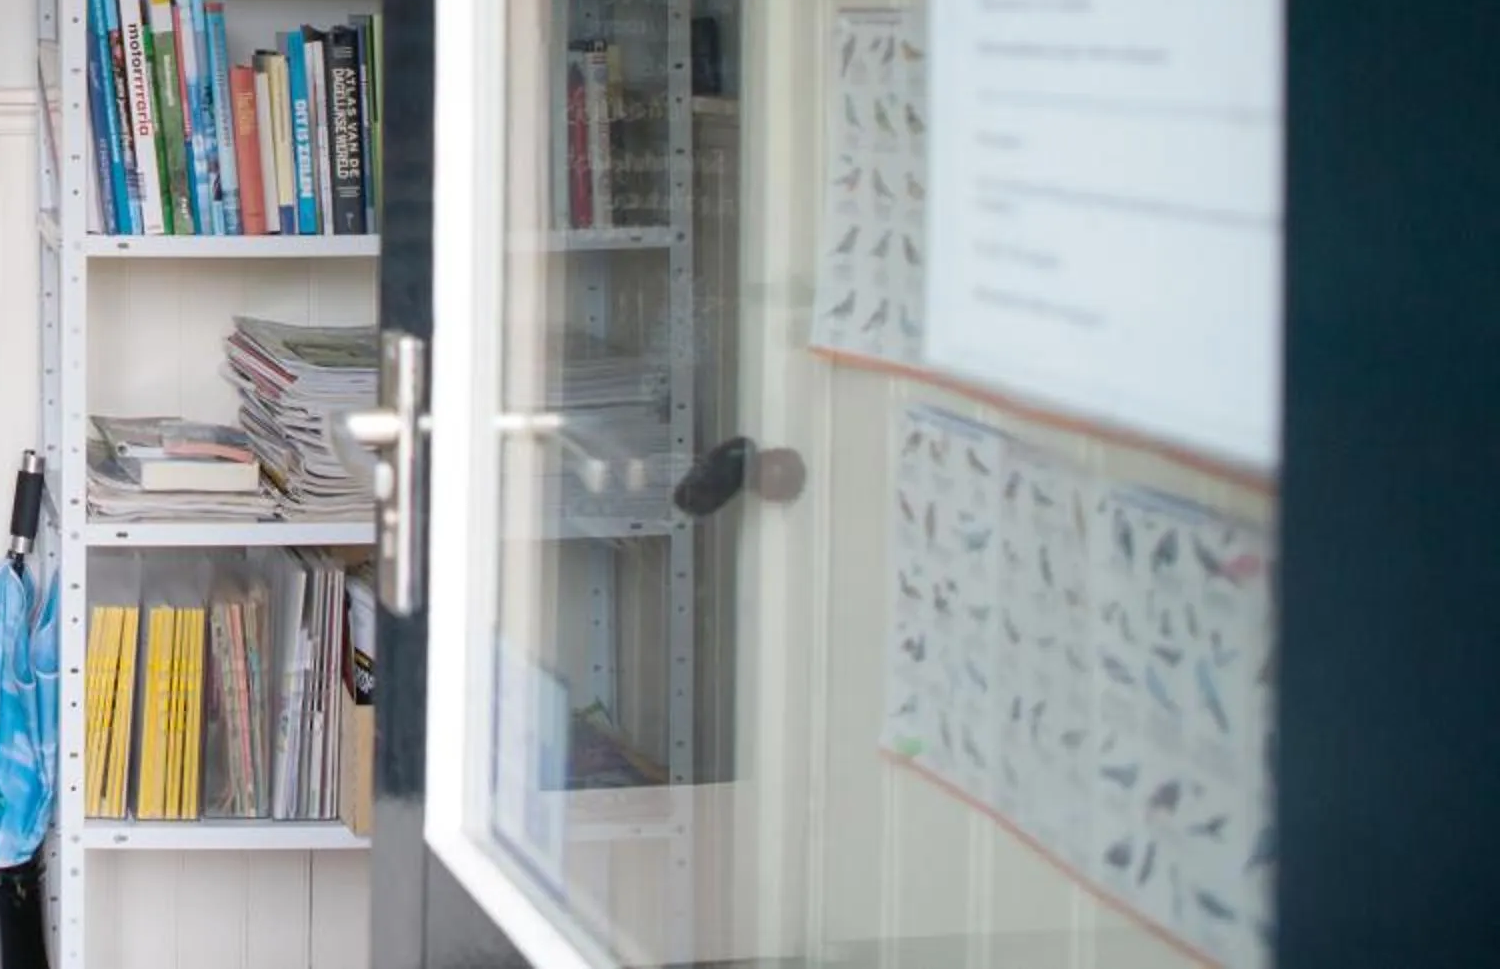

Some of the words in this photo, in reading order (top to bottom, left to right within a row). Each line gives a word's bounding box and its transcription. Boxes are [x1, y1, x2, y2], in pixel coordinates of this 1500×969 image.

[293, 98, 308, 125] DIT
[332, 67, 348, 133] DAGELIJKSE
[344, 66, 358, 118] ATLAS
[296, 127, 309, 142] IS
[347, 121, 360, 153] VAN
[298, 143, 315, 198] ZEILEN
[336, 134, 350, 180] WERELD
[349, 157, 361, 179] DE
